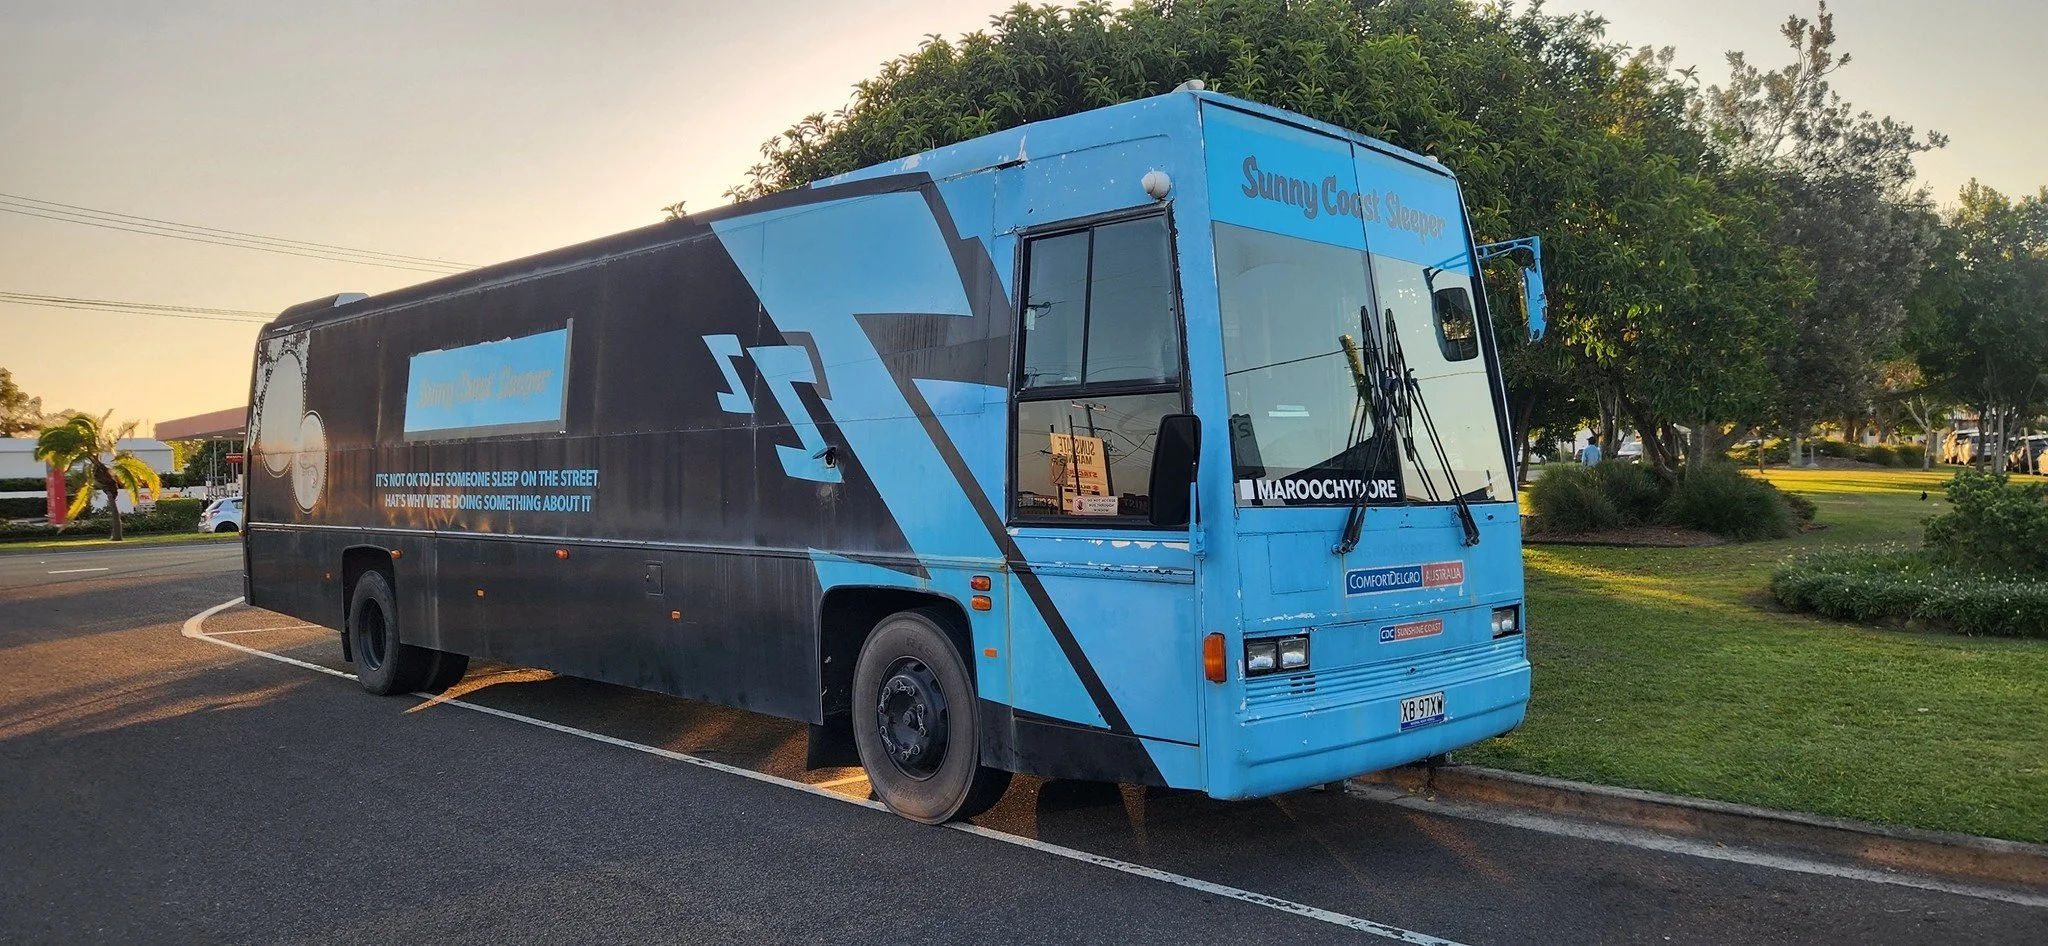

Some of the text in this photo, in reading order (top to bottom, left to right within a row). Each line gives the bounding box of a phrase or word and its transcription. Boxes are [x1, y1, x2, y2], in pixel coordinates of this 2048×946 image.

[1241, 155, 1446, 245] Sunny Coast Sleeper
[416, 373, 455, 413] Sunny
[375, 472, 389, 487] IT'S
[389, 472, 405, 487] NOT
[406, 472, 418, 487] OK
[419, 472, 430, 487] TO
[431, 472, 445, 487] LET
[445, 471, 490, 487] SOMEONE
[491, 470, 519, 487] SLEEP
[520, 470, 537, 487] ON
[539, 469, 559, 487] THE
[406, 493, 427, 508] WHY
[426, 494, 451, 509] WE'RE
[452, 494, 482, 510] DOING
[483, 494, 541, 511] SOMETHING
[542, 494, 580, 512] ABOUT
[581, 495, 592, 512] IT
[1425, 567, 1462, 582] AUSTRALIA
[1381, 622, 1441, 640] CDC SUNSHINE COAST
